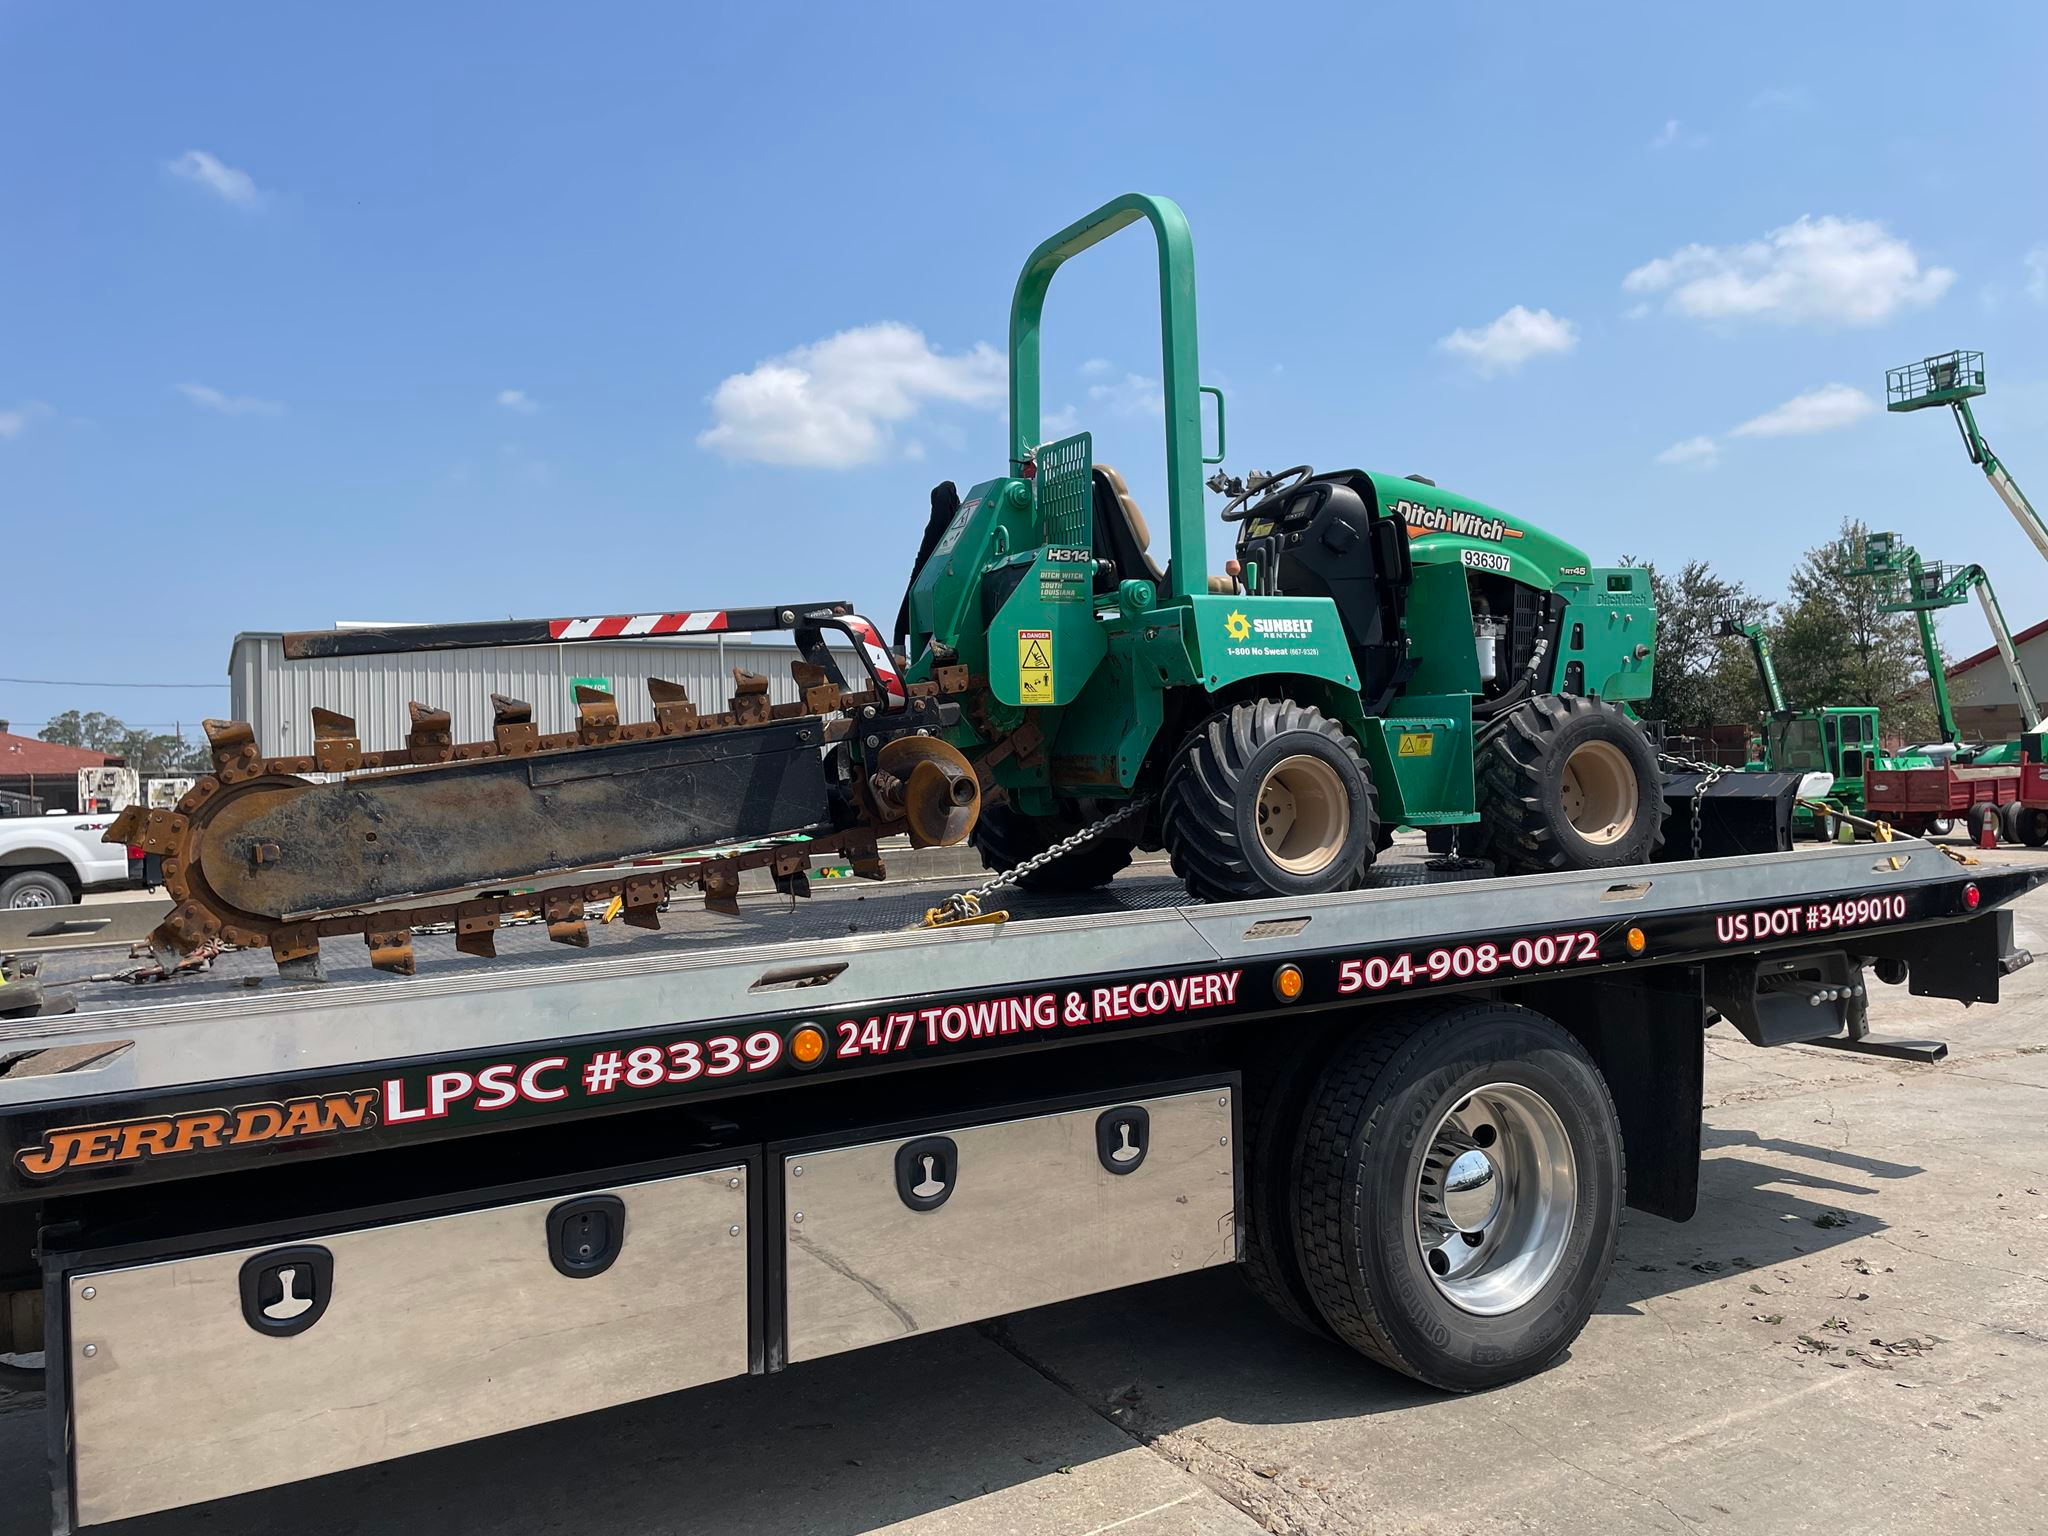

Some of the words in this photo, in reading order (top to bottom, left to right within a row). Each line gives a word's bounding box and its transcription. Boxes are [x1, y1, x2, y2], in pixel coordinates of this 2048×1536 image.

[1396, 500, 1448, 531] Ditch
[1451, 510, 1506, 541] Witch
[1047, 549, 1090, 562] H314
[1464, 551, 1510, 571] 936307
[1253, 619, 1313, 632] SUNBELT
[1227, 648, 1250, 656] 1-800
[1251, 647, 1263, 656] No
[1264, 647, 1289, 656] Sweat
[1715, 914, 1749, 943] US
[1753, 907, 1802, 939] DOT
[1806, 895, 1906, 932] #3499010
[1338, 931, 1600, 994] 504-908-0072
[837, 1013, 916, 1058] 24/7
[921, 993, 1056, 1046] TOWING
[1062, 989, 1091, 1026] &
[1093, 970, 1243, 1021] RECOVERY
[384, 1057, 569, 1126] LPSC
[582, 1030, 783, 1096] #8339
[17, 1091, 376, 1176] JERR-DAN
